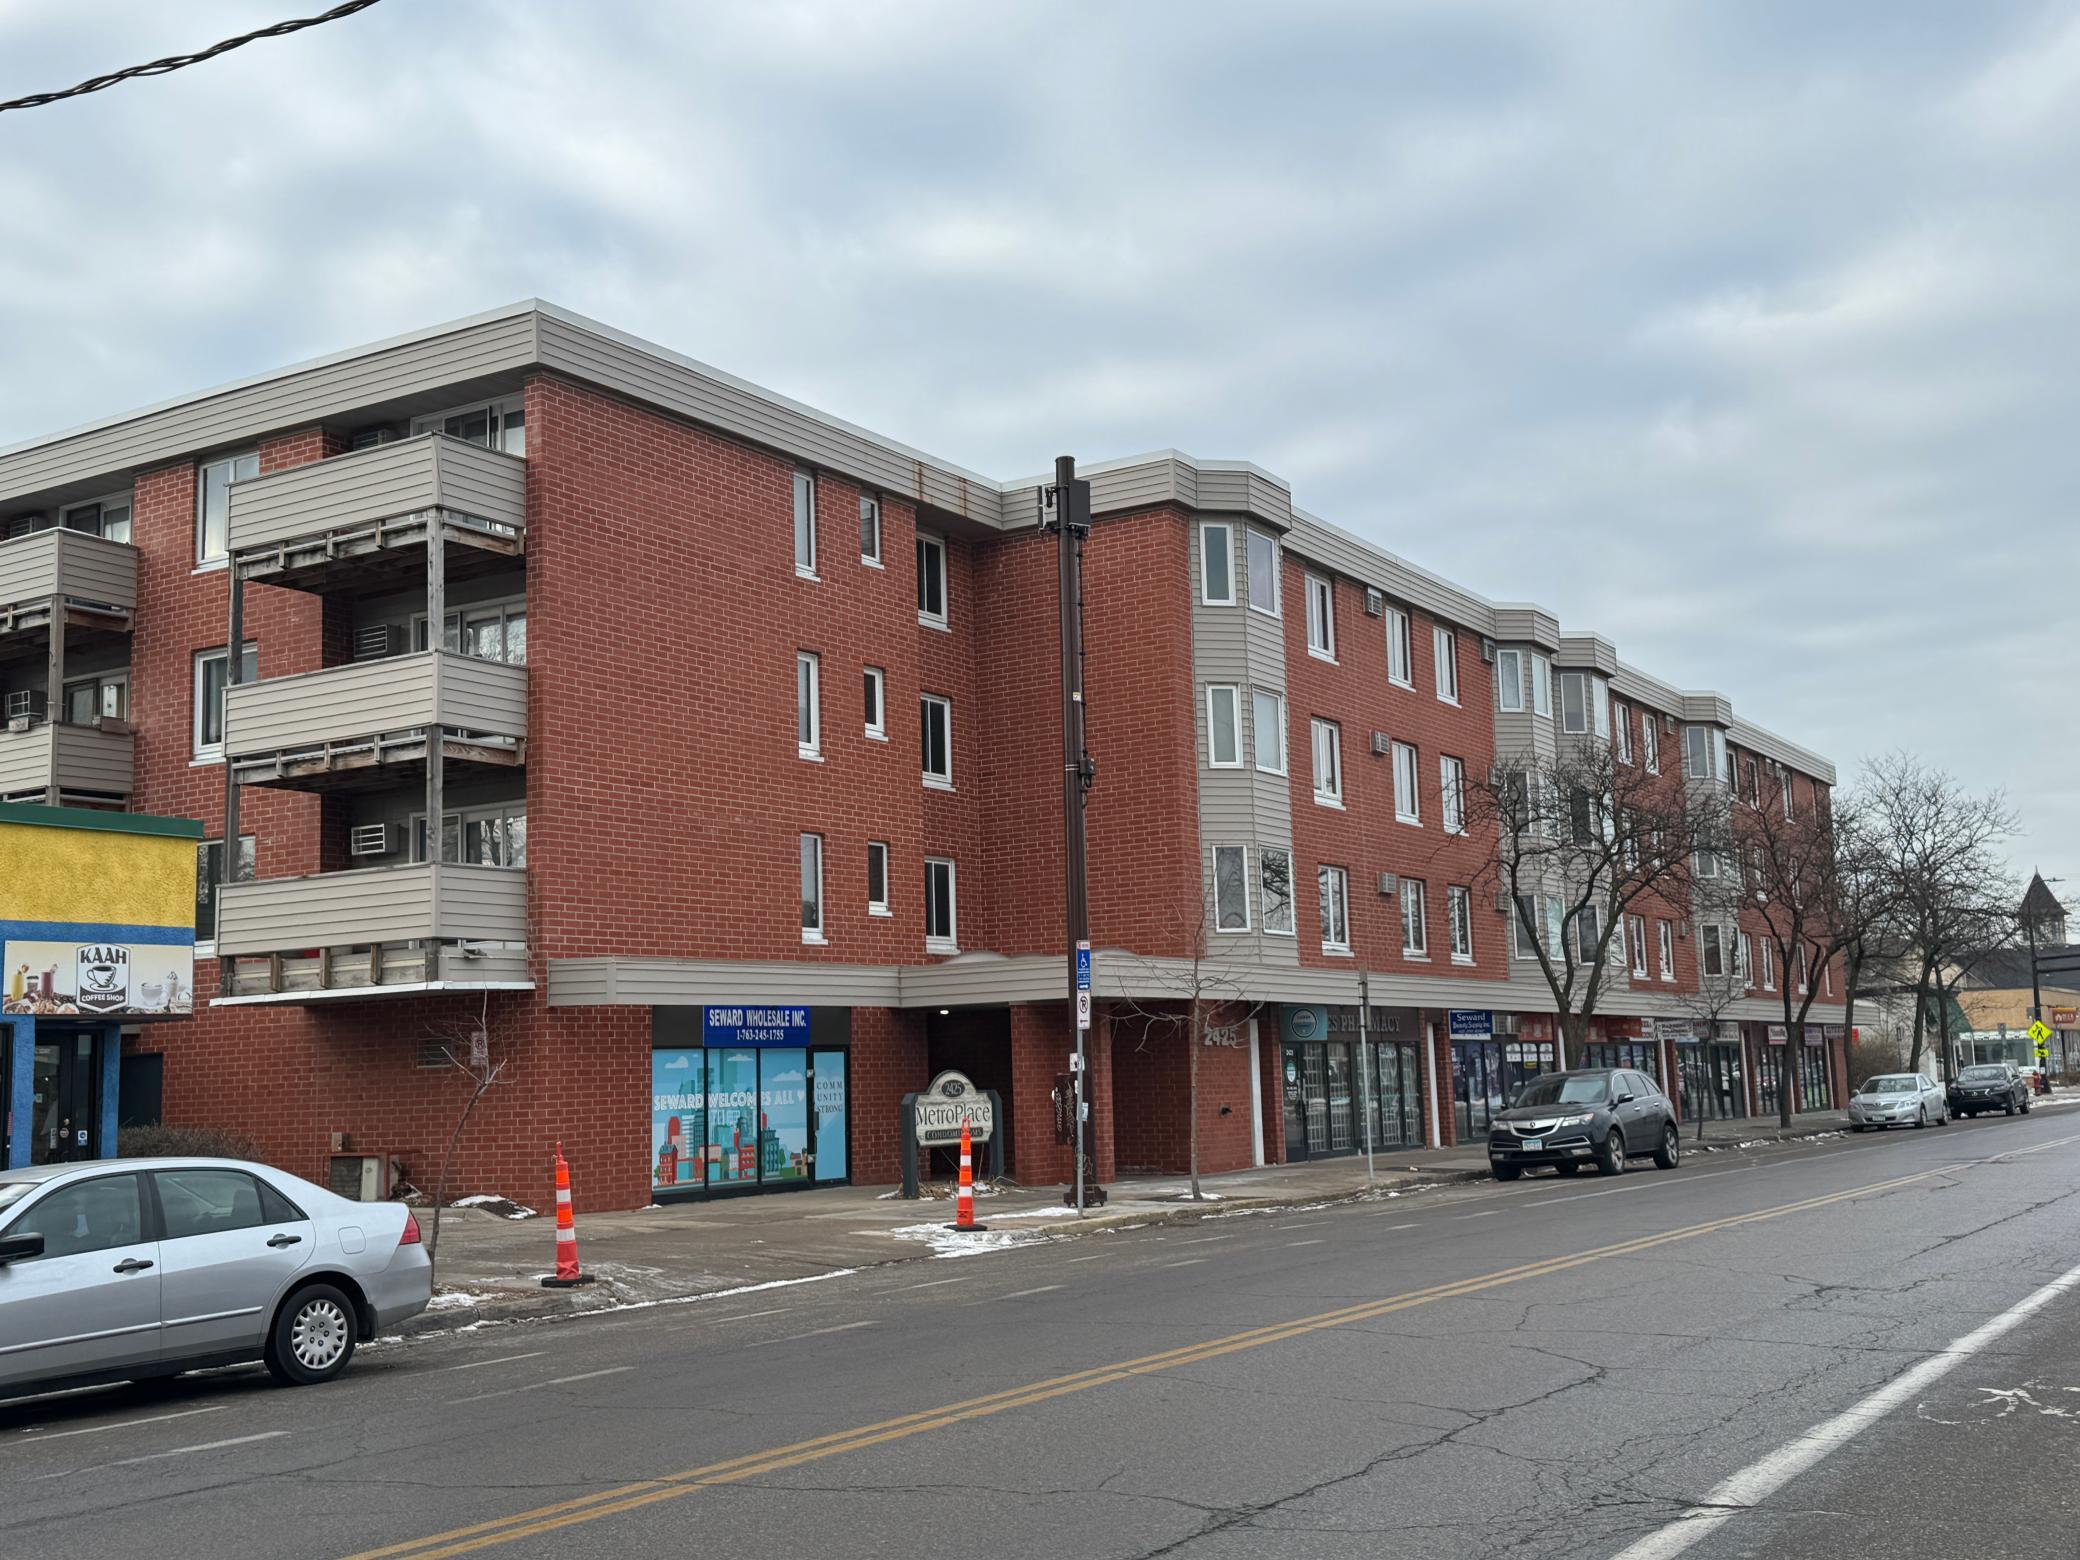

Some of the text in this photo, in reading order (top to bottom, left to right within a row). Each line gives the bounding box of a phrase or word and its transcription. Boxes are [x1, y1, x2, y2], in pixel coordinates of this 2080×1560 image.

[80, 946, 127, 965] KAAH
[81, 994, 125, 1003] COFFEE SHOP
[709, 1009, 744, 1027] SEWARD
[746, 1009, 790, 1027] WHOLESALE
[1456, 1012, 1486, 1022] Seward
[1204, 1027, 1237, 1046] 2425
[816, 1081, 843, 1090] COMM
[945, 1082, 962, 1096] 2425
[654, 1094, 704, 1111] SEWARD
[774, 1090, 795, 1106] ALL
[816, 1092, 844, 1102] UNITY
[916, 1103, 991, 1126] MetroPlace
